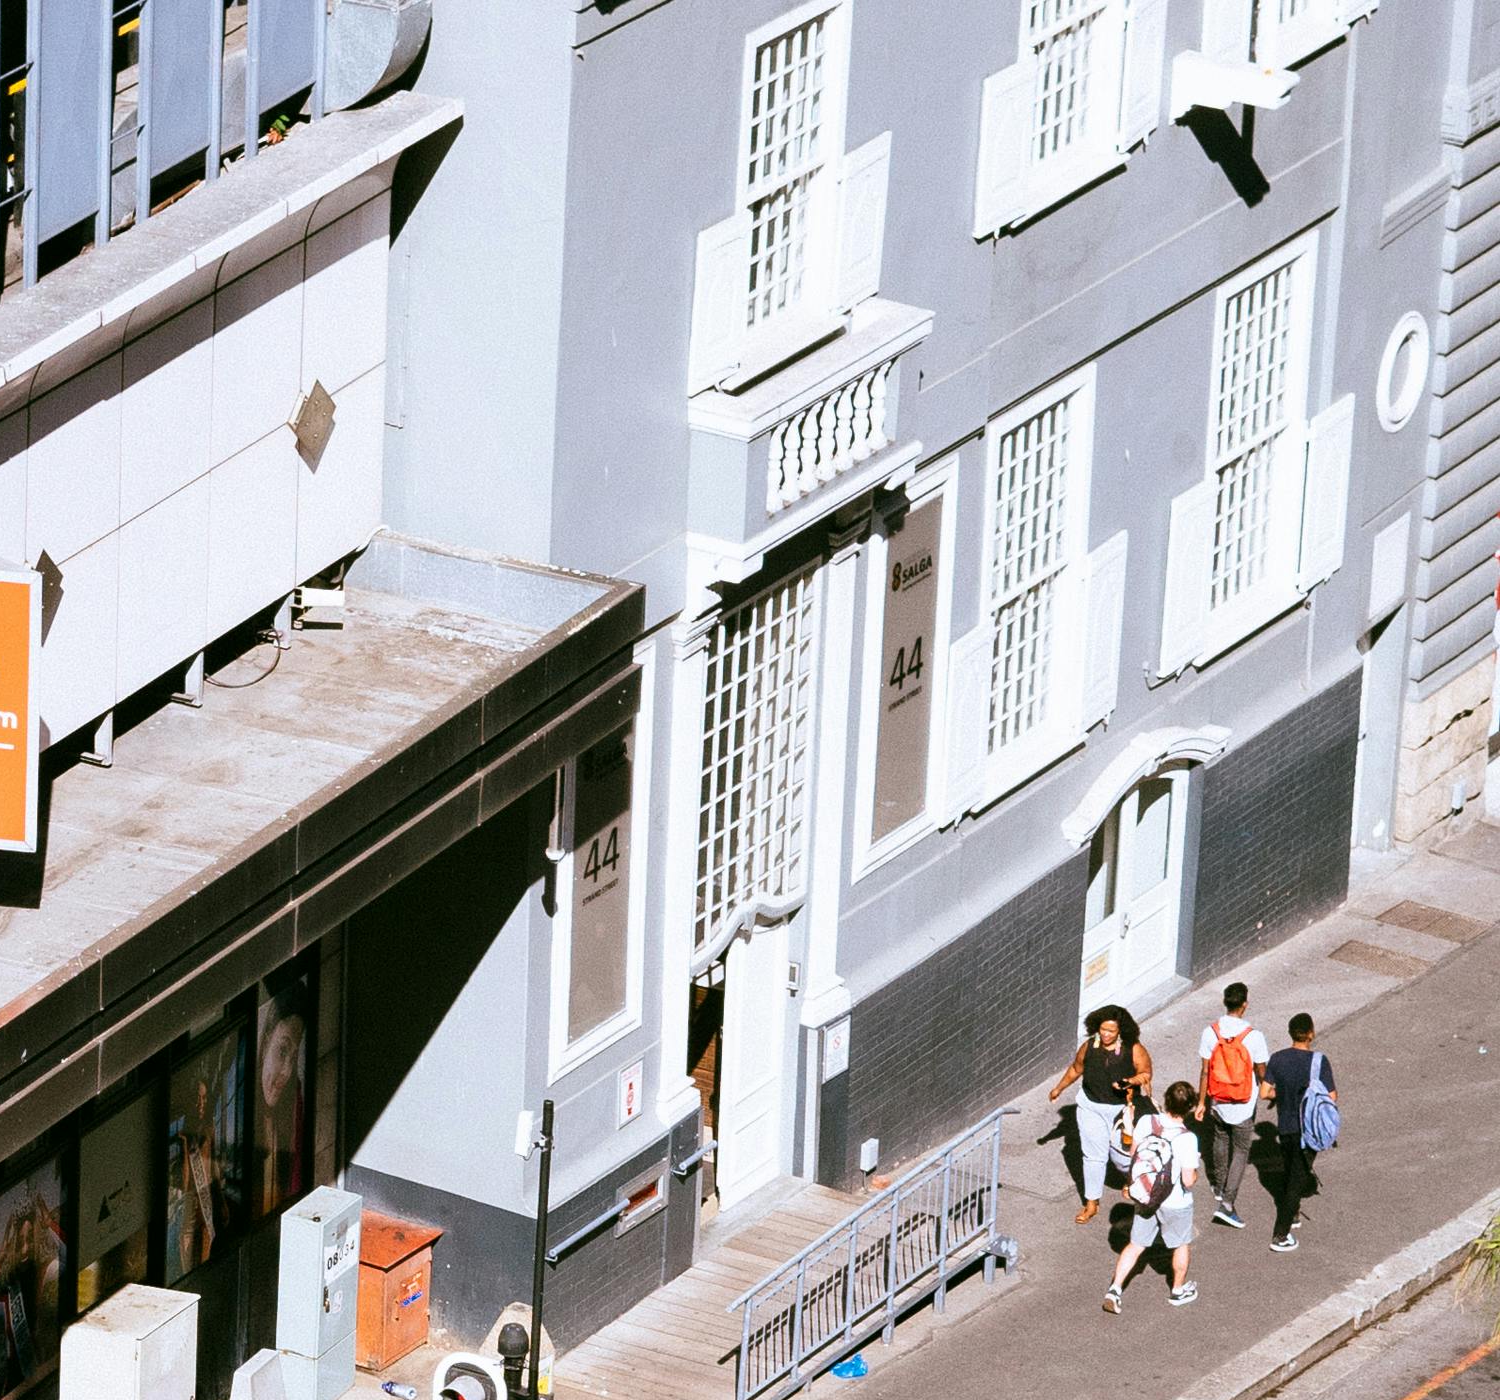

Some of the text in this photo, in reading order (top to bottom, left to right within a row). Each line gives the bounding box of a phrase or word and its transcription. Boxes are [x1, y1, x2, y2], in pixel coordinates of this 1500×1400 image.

[902, 555, 933, 584] SALGA
[890, 636, 924, 691] 44
[583, 827, 620, 883] 44
